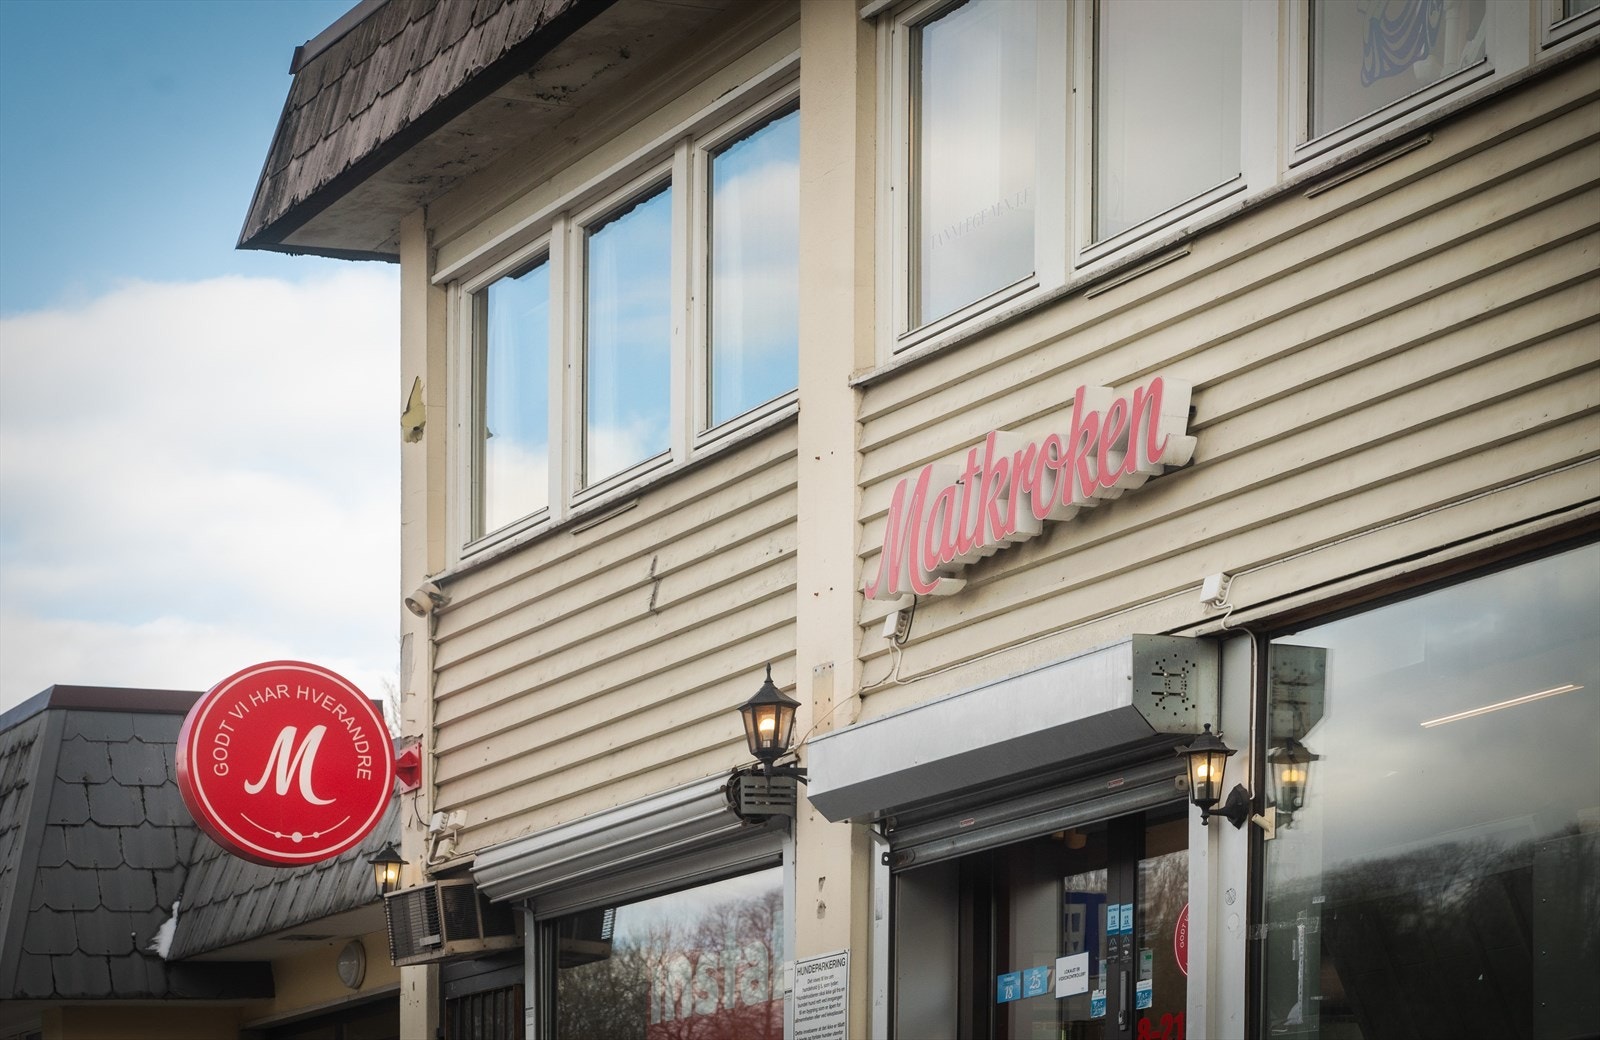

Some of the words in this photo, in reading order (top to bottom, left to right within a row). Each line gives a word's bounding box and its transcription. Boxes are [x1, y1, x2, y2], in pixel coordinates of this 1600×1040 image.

[864, 376, 1171, 600] Matkroken
[212, 719, 235, 777] GODT
[228, 701, 250, 720] VI
[249, 684, 290, 707] HAR
[296, 685, 372, 781] HVERANDRE
[244, 724, 337, 806] M
[796, 957, 846, 977] HUNDEPARKERING
[1030, 974, 1041, 989] 25
[1138, 1011, 1185, 1040] 8-21
